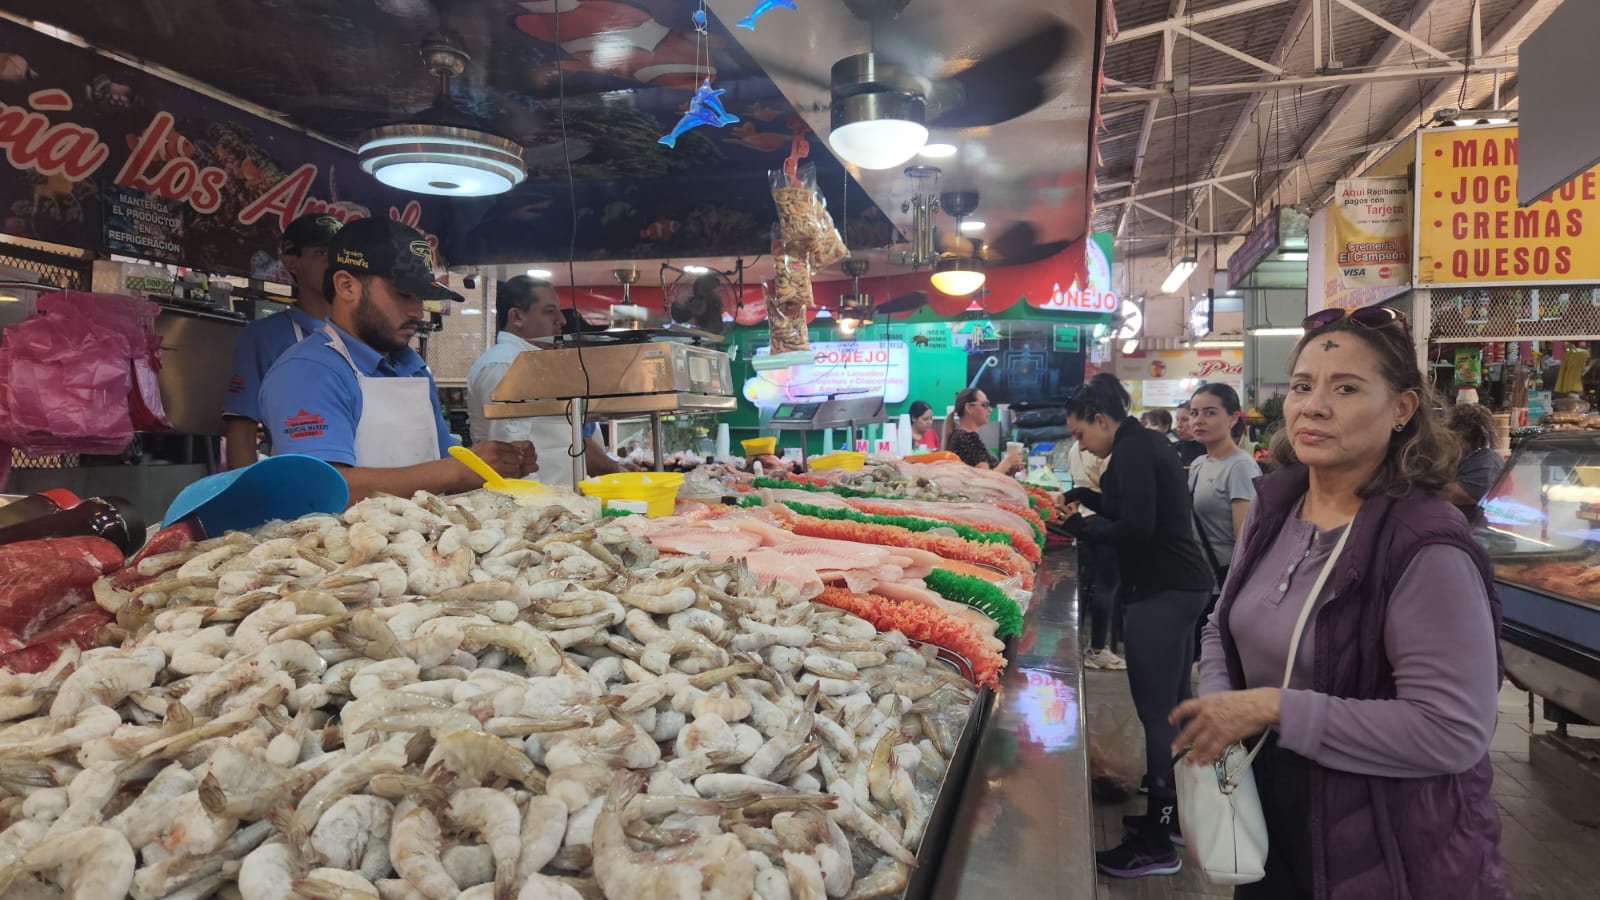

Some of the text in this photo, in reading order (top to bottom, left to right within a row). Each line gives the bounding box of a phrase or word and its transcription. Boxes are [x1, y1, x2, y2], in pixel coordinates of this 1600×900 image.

[113, 111, 228, 214] Los
[1453, 138, 1519, 168] MAN
[1367, 188, 1407, 196] Recibimos
[1451, 171, 1596, 205] JOCUE
[119, 193, 169, 214] MANTENGA
[1344, 198, 1368, 206] pagos
[1366, 204, 1404, 217] Tarjeta
[112, 205, 176, 228] EL PRODUCTO
[1452, 208, 1583, 240] CREMAS
[139, 224, 151, 234] EN
[108, 230, 180, 253] REFRIGERACIÓN
[1340, 252, 1350, 263] El
[1452, 246, 1572, 279] QUESOS
[1343, 268, 1366, 277] VISA
[1053, 289, 1116, 311] ONEJO
[815, 351, 888, 364] CONEJO
